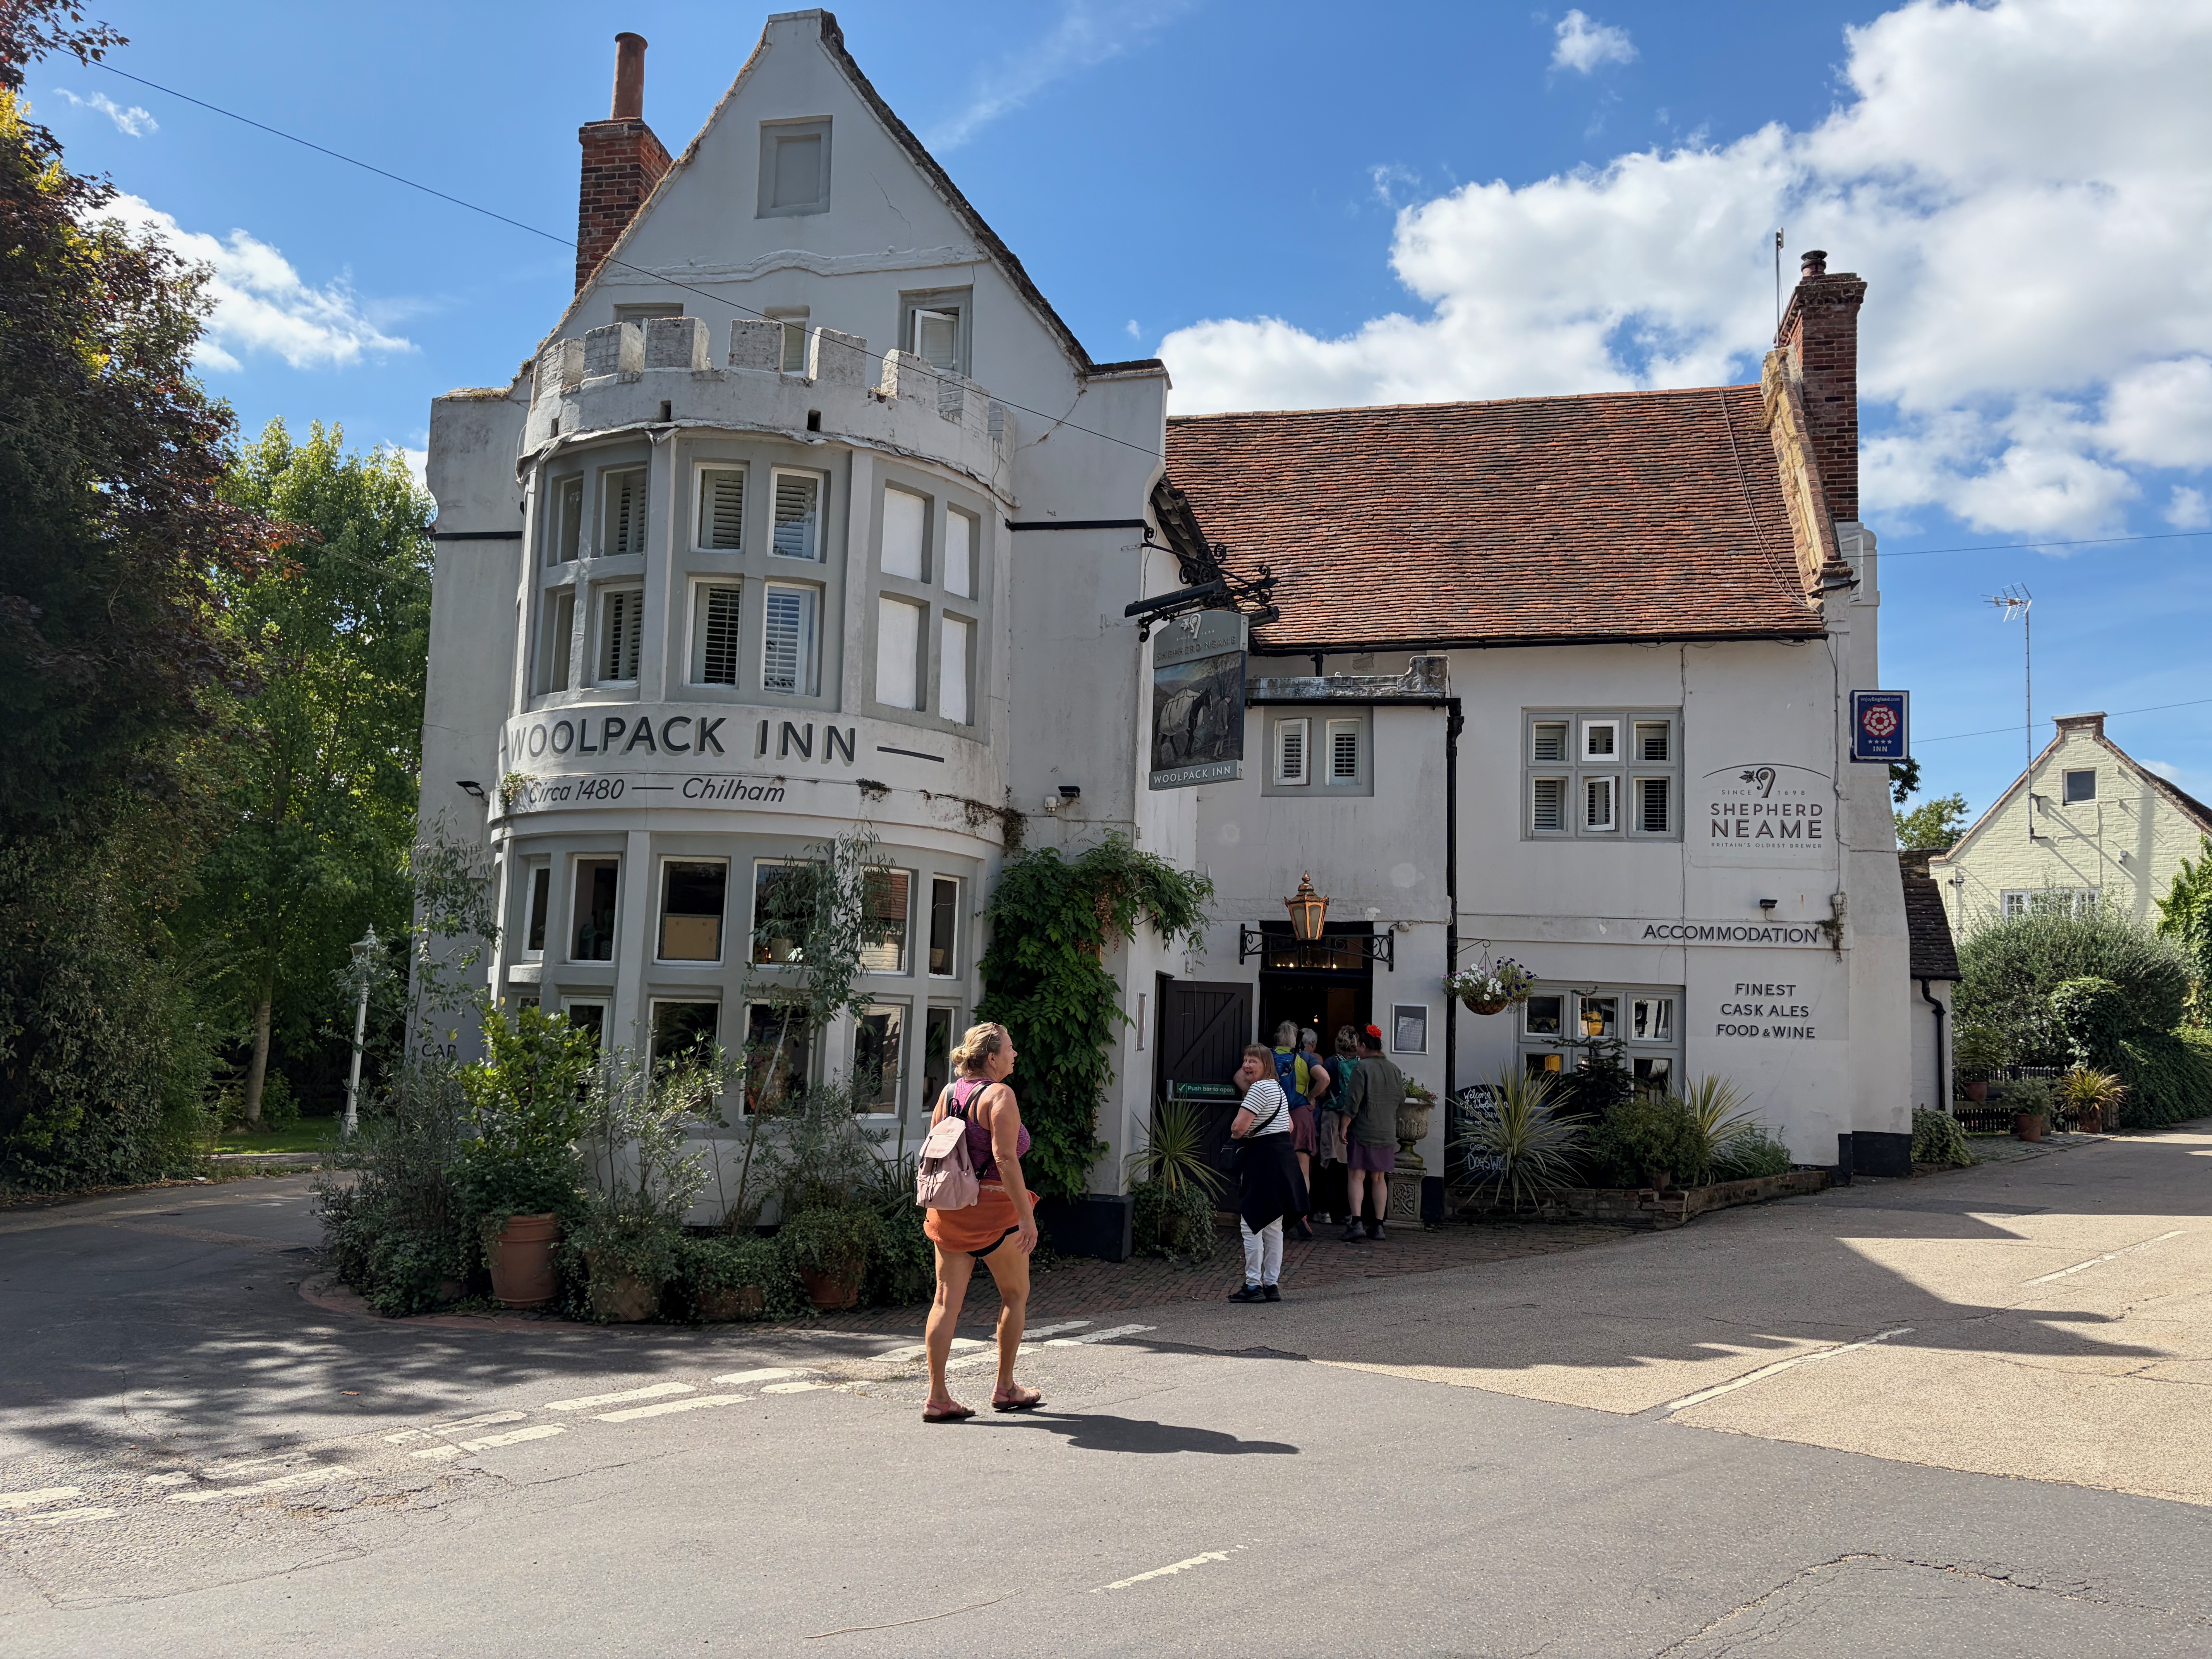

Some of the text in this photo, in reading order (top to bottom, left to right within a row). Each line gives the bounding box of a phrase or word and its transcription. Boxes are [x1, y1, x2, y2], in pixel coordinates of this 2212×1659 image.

[1156, 636, 1236, 661] SHEPHERD NEAME
[511, 716, 855, 765] WOOLPACK INN
[1154, 766, 1231, 784] WOOLPACK INN
[529, 777, 785, 804] Circa 1480 Chilham
[1711, 803, 1823, 816] SHEPHERD
[1711, 818, 1822, 838] NEAME
[1642, 924, 1818, 944] ACCOMMODATION
[1735, 983, 1796, 996] FINEST
[1721, 1003, 1809, 1018] CASK ALES
[1716, 1024, 1815, 1039] FOOD & WINE
